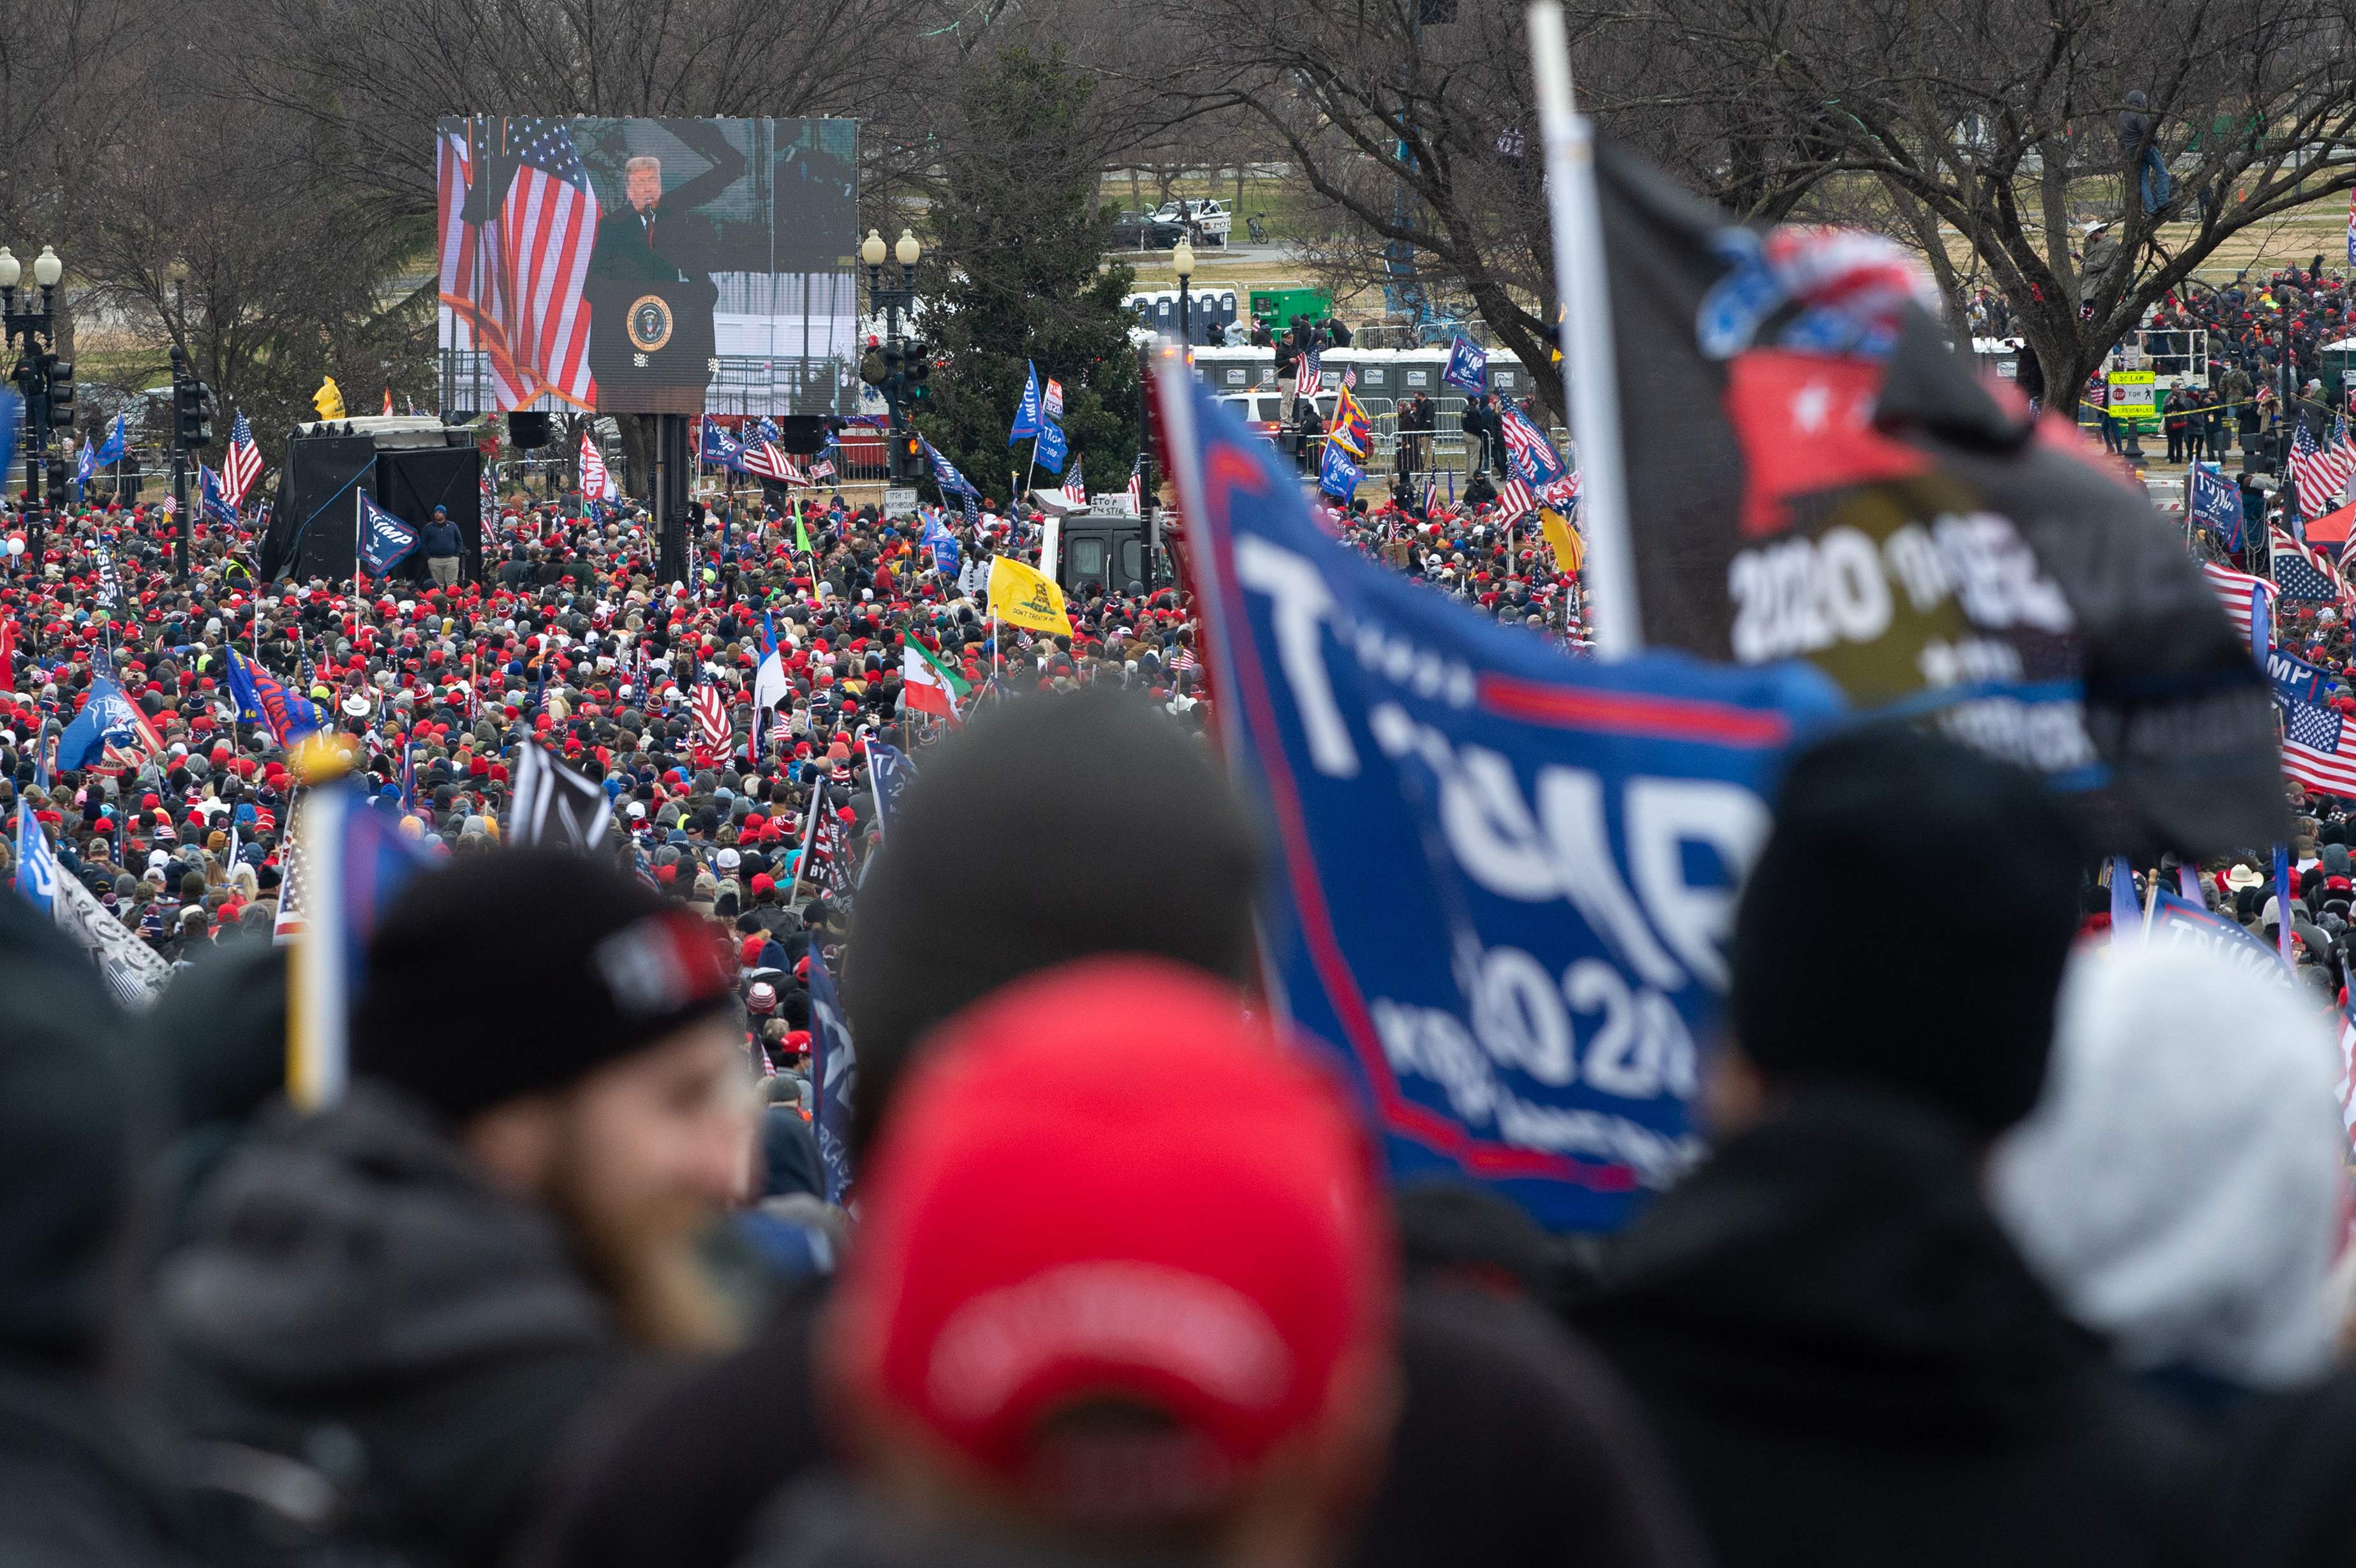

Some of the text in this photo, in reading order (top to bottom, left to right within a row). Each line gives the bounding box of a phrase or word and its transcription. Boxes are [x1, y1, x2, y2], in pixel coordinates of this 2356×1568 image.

[1092, 498, 1117, 506] STOP
[2194, 509, 2209, 518] KEEP
[366, 505, 413, 544] RUMP
[810, 865, 827, 880] BY
